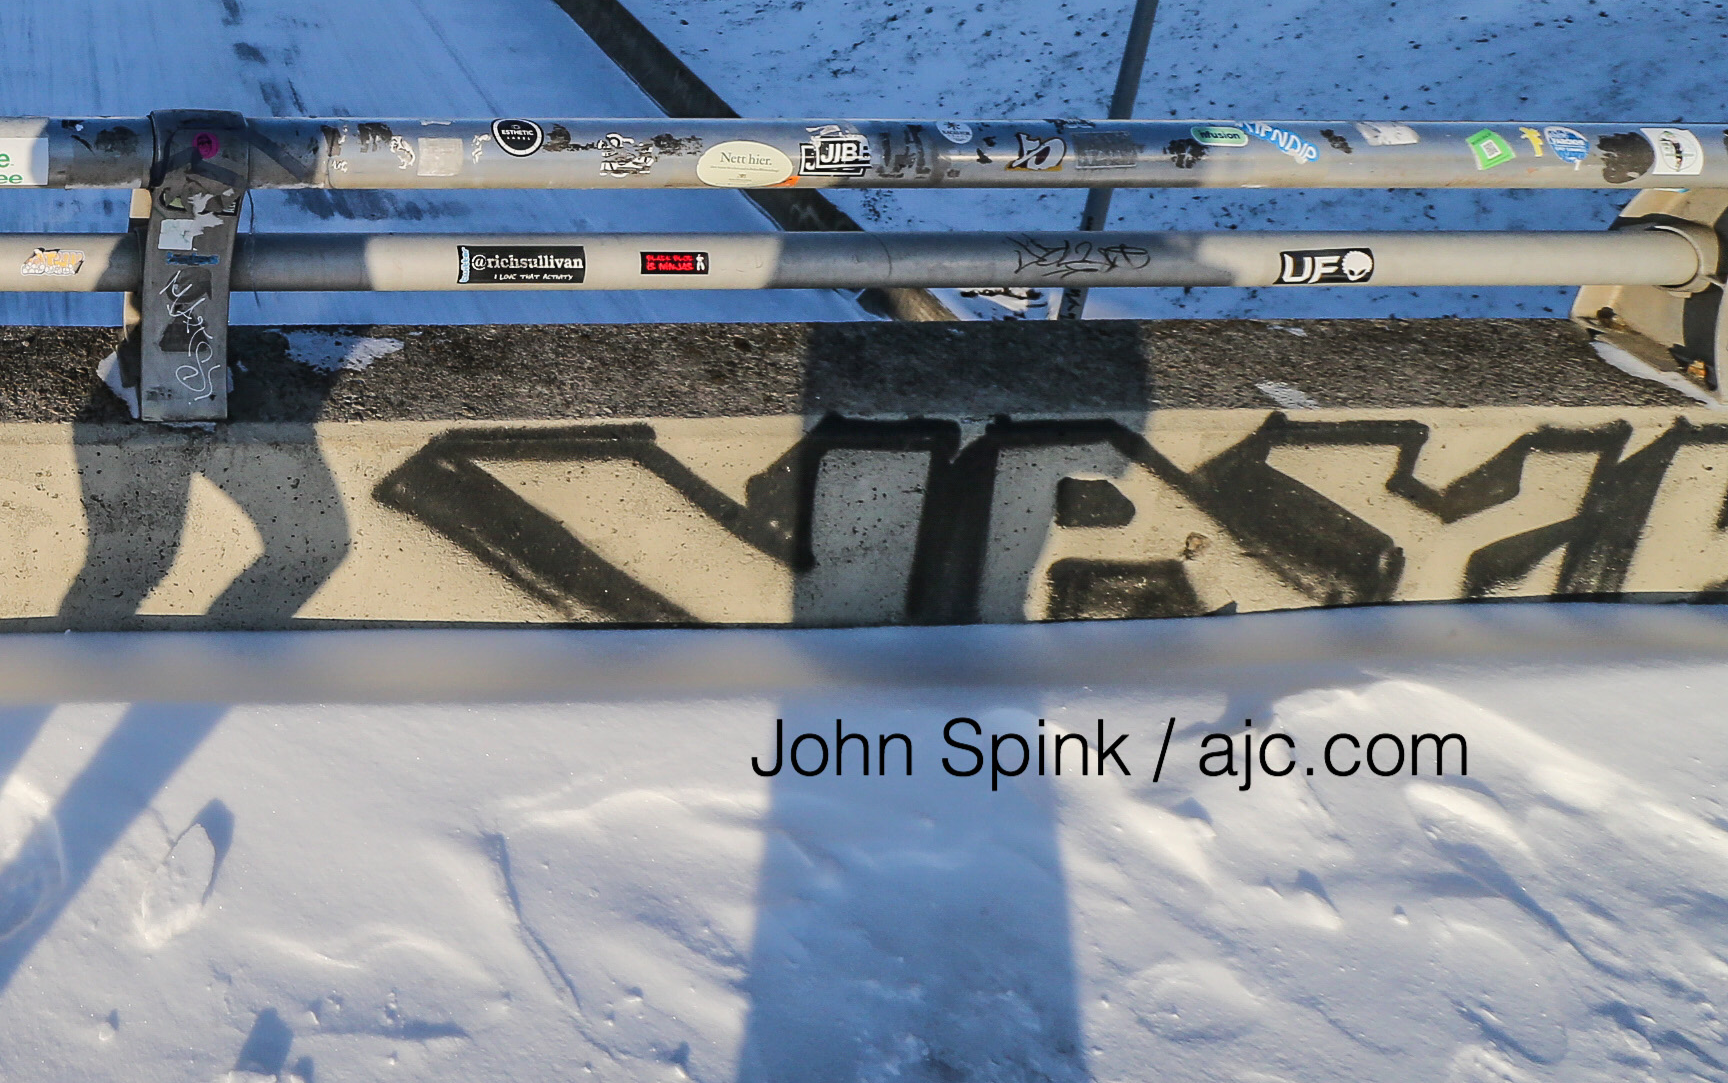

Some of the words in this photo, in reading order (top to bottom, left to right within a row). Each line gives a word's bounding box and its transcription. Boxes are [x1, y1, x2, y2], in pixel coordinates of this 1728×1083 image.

[719, 151, 746, 164] Nett
[748, 152, 773, 166] hier.
[471, 253, 583, 271] @richsullivan
